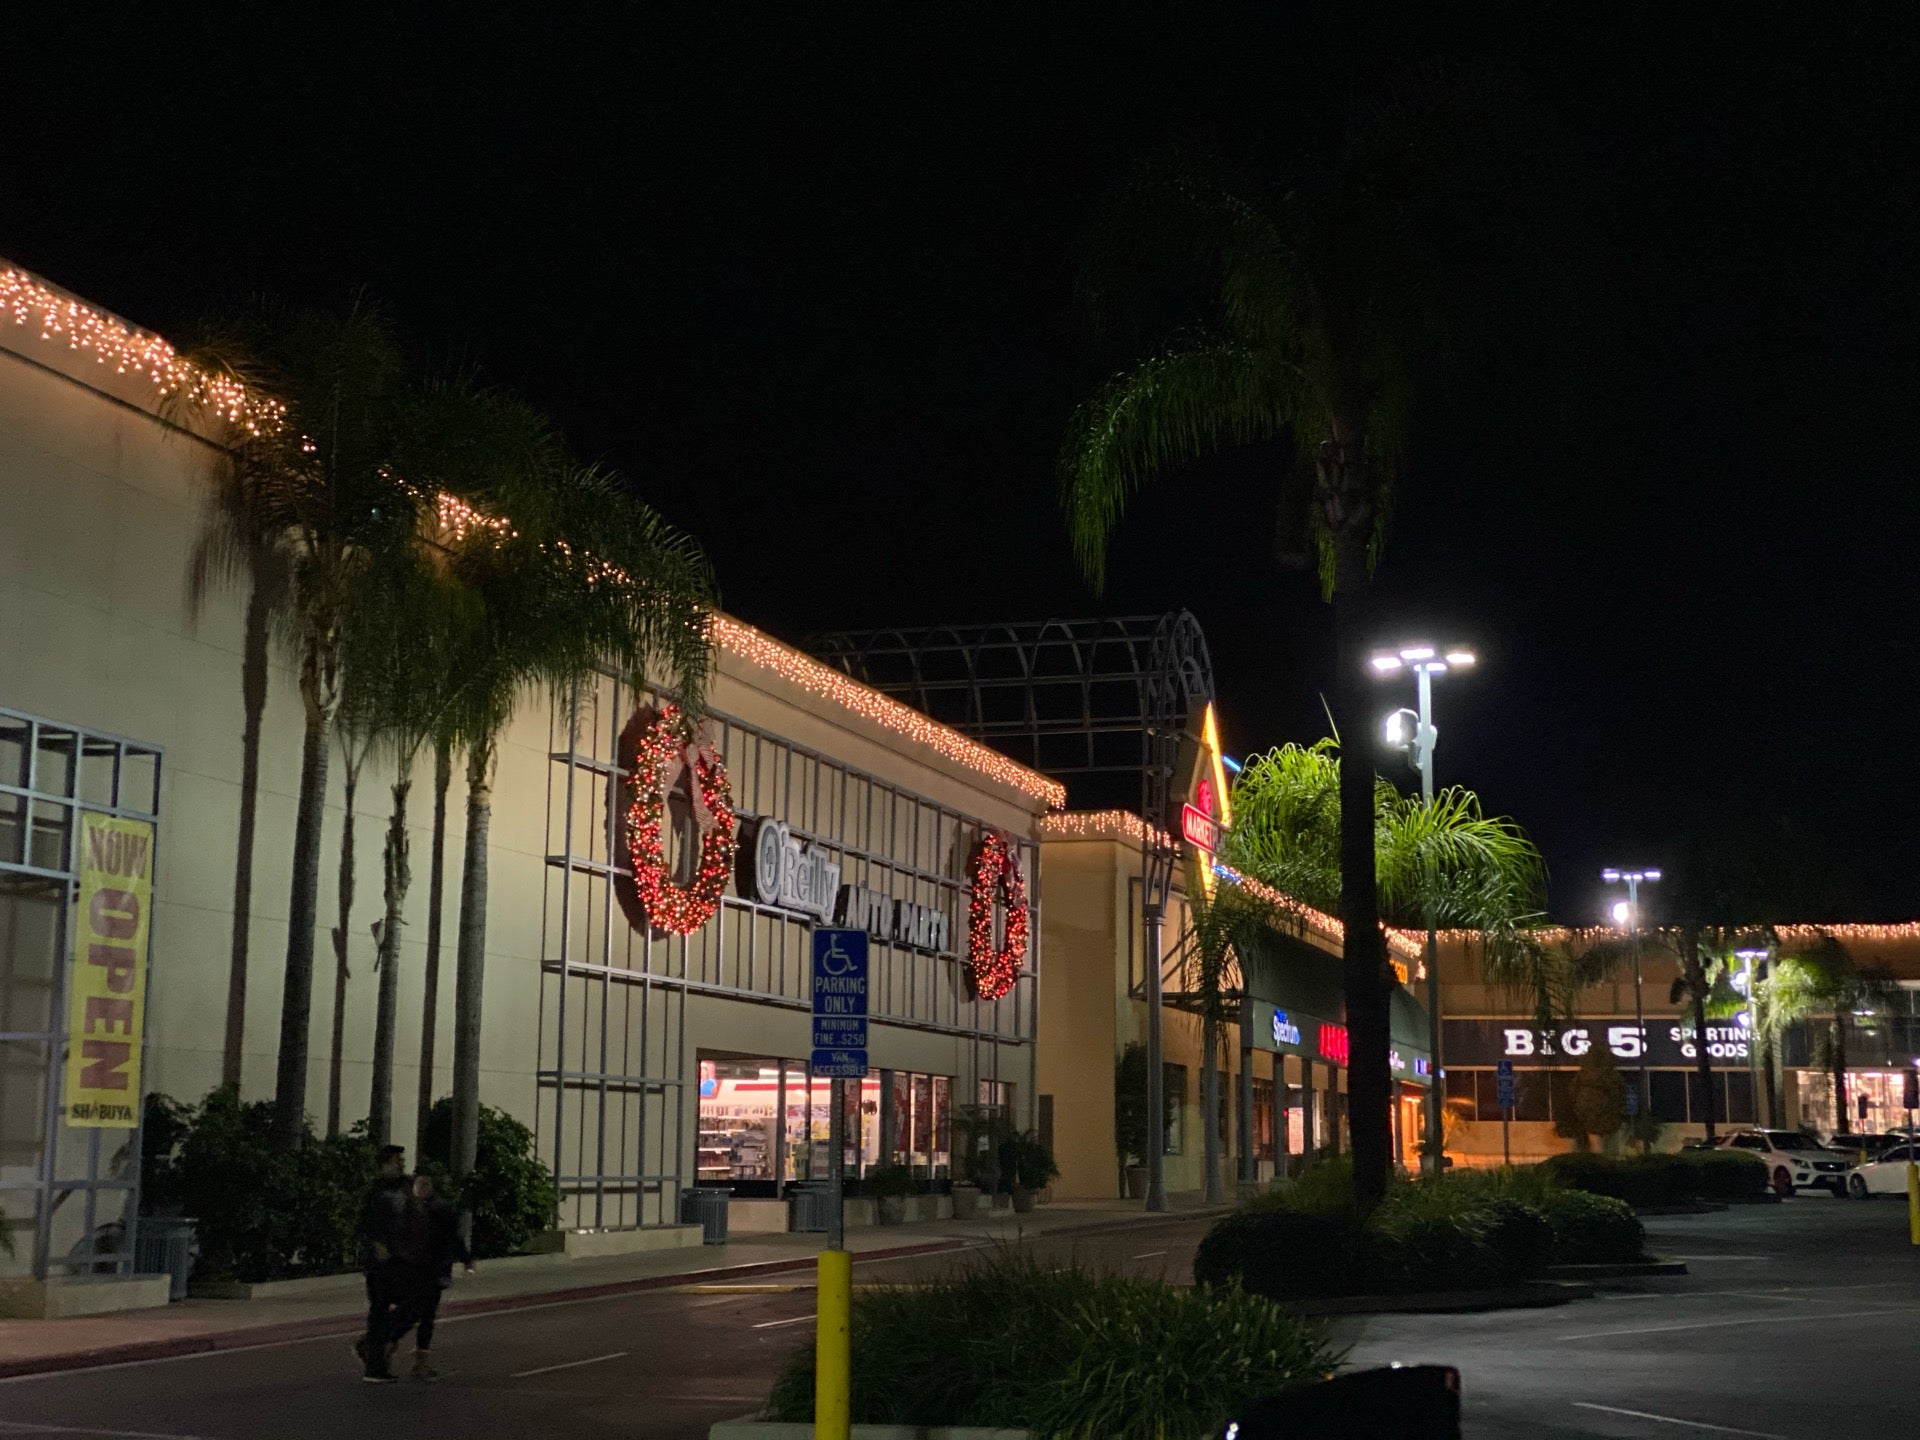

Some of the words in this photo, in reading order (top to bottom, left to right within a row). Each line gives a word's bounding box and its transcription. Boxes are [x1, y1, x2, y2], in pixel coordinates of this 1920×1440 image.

[87, 826, 149, 879] NOW
[758, 818, 839, 924] O'Reilly
[845, 885, 893, 939] AUTO
[900, 900, 949, 951] PARTS
[79, 887, 140, 1091] OPEN
[815, 976, 865, 994] PARKING
[824, 996, 855, 1013] ONLY
[820, 1019, 859, 1031] MINIMUM
[815, 1033, 834, 1045] FINE
[1608, 1027, 1648, 1057] 5
[1670, 1027, 1761, 1042] SPRTIN
[831, 1052, 849, 1062] VAN
[1681, 1043, 1749, 1057] GODS
[813, 1065, 866, 1076] ACCESSIBLE
